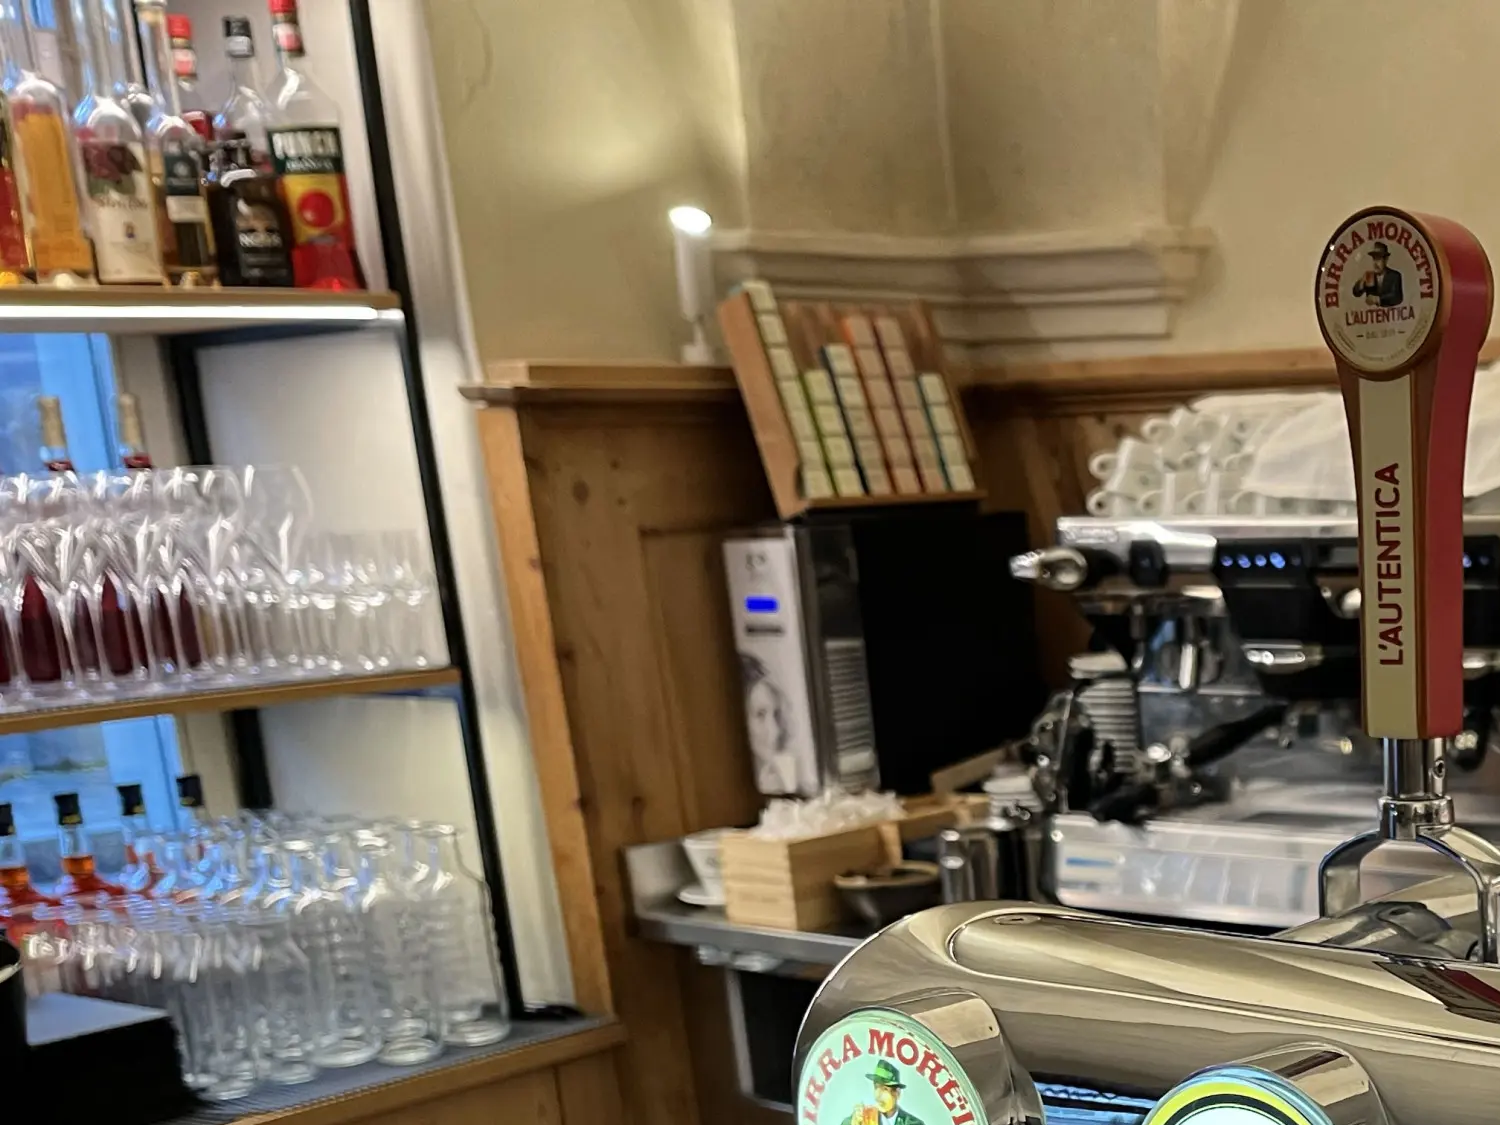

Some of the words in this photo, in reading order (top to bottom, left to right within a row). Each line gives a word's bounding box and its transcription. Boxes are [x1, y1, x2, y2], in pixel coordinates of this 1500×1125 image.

[1325, 230, 1365, 309] BIRRA
[1367, 221, 1434, 300] MORETTI
[1345, 305, 1415, 327] L'AUTENTICA
[1374, 462, 1404, 665] L'AUTENTICA
